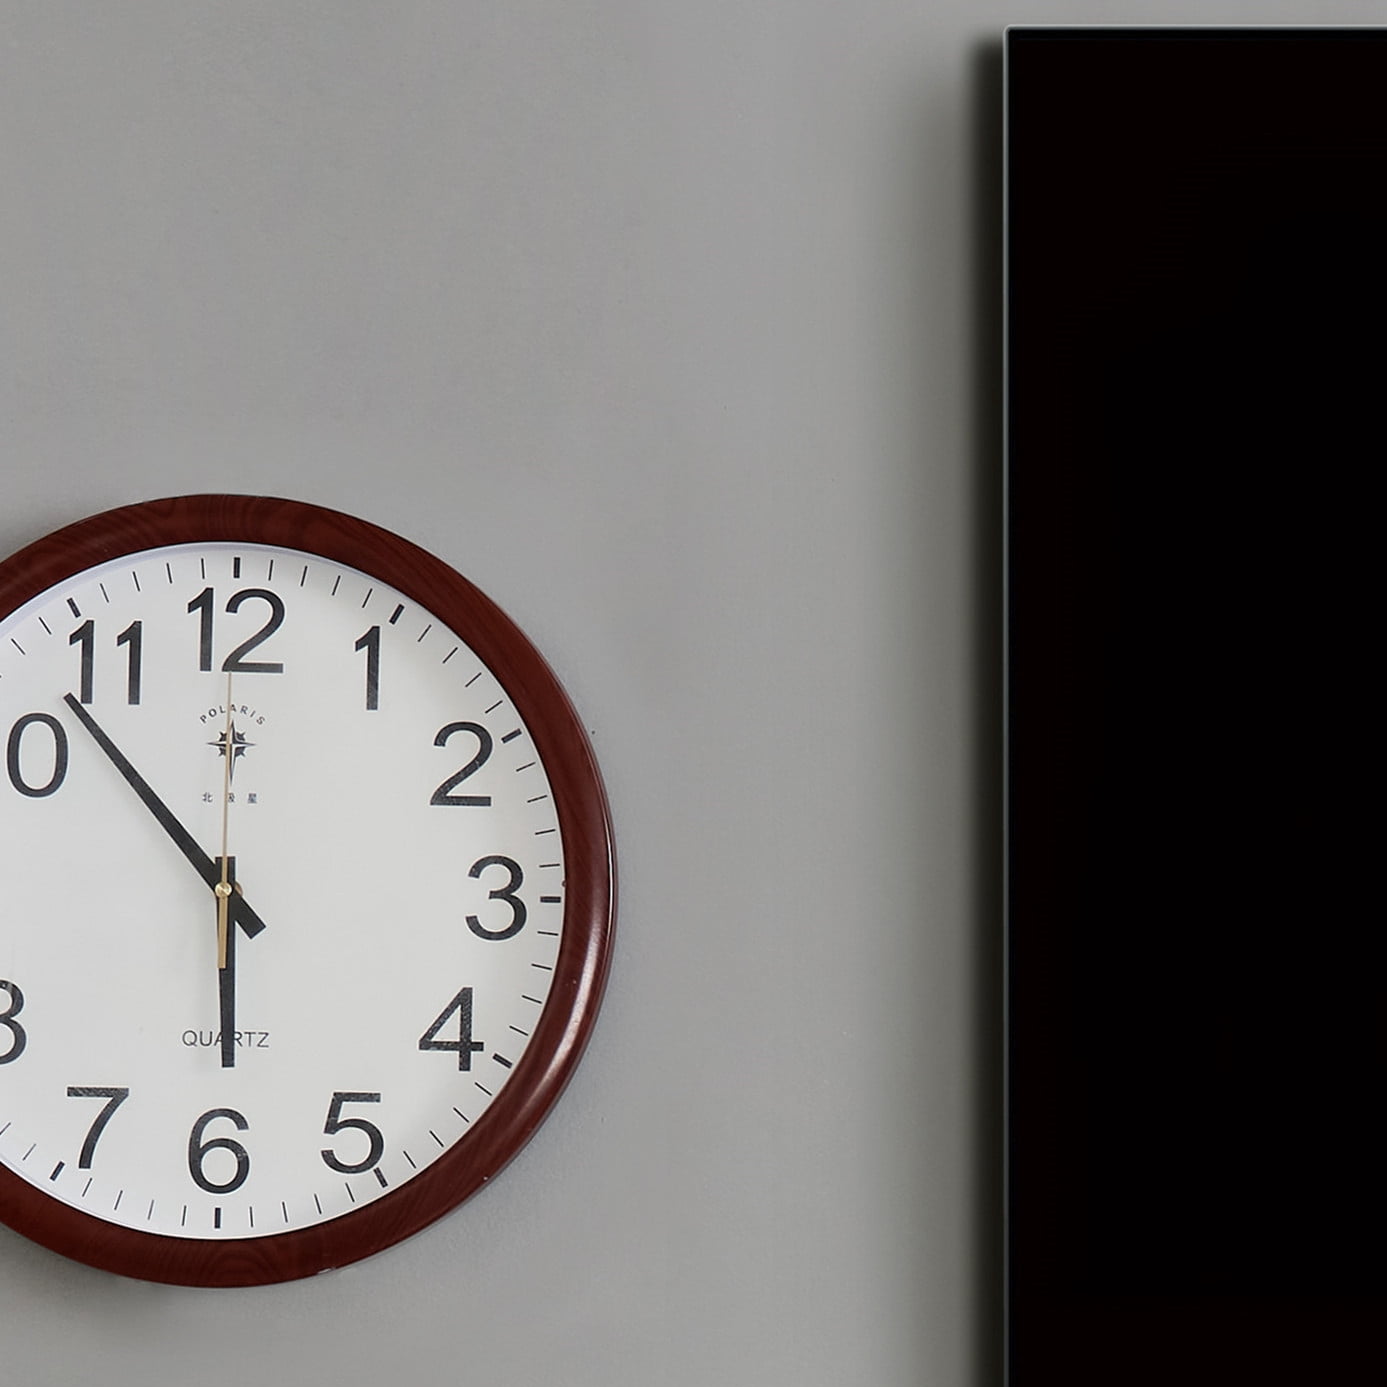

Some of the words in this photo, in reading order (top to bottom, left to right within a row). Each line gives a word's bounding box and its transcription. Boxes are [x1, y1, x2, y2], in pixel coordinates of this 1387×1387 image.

[69, 619, 142, 704] 11
[187, 587, 285, 674] 12
[355, 625, 381, 711] 1
[6, 711, 69, 798] 0
[200, 704, 265, 725] POLARIS
[430, 721, 493, 807] 2
[465, 855, 528, 941] 3
[418, 987, 485, 1072] 4
[66, 1086, 129, 1170] 7
[188, 1108, 250, 1195] 6
[320, 1091, 384, 1174] 5
